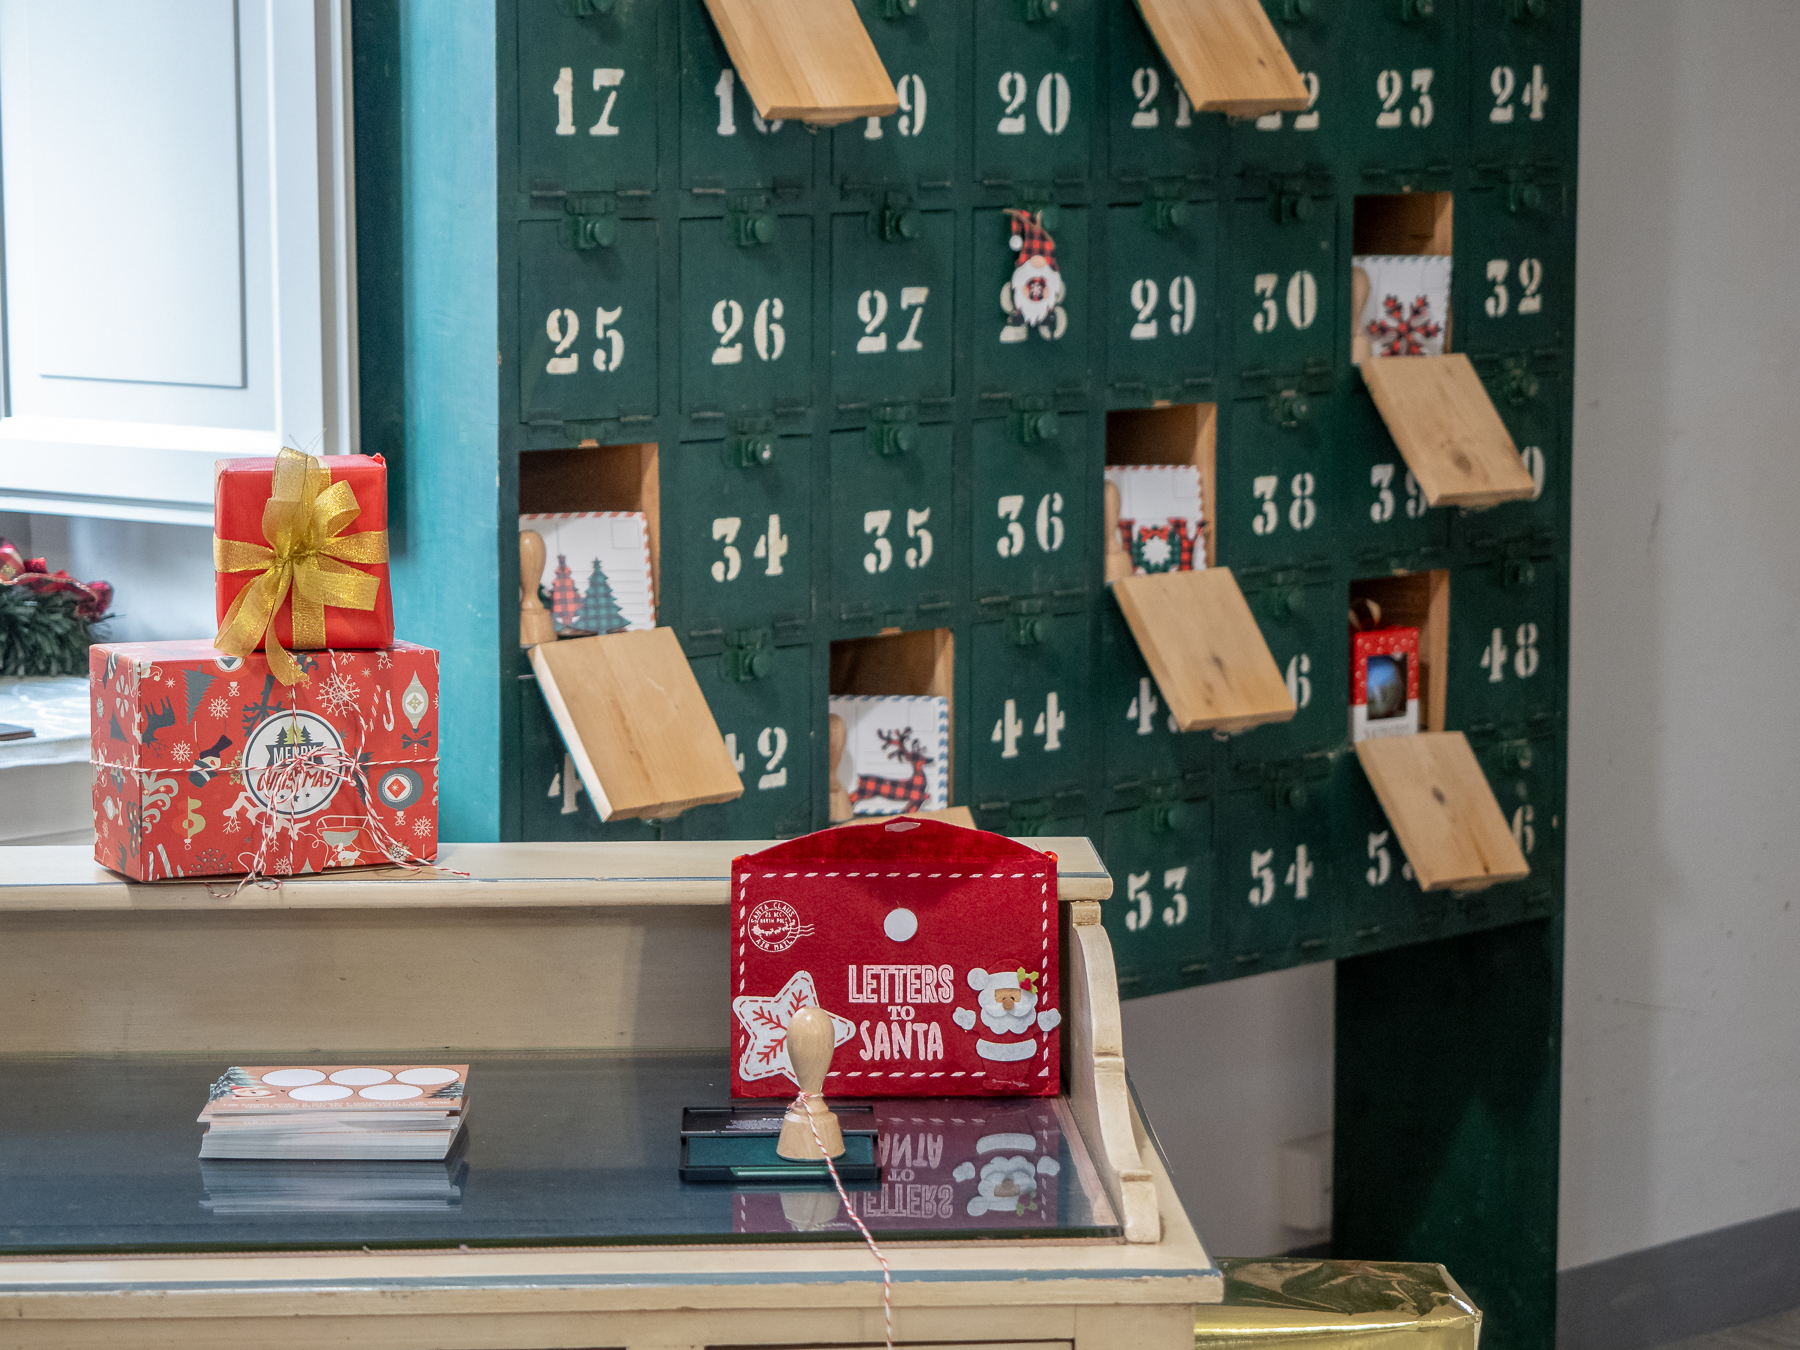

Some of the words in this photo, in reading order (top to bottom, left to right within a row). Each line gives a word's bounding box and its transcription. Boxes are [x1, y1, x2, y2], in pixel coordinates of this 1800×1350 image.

[553, 67, 625, 136] 17
[715, 70, 783, 136] 1
[998, 72, 1070, 134] 20
[1377, 69, 1433, 127] 23
[1490, 65, 1547, 122] 24
[1131, 276, 1196, 340] 29
[1254, 271, 1317, 332] 30
[1486, 259, 1541, 316] 32
[546, 306, 625, 375] 25
[712, 298, 785, 365] 26
[857, 287, 929, 353] 27
[997, 493, 1064, 557] 36
[1253, 473, 1315, 535] 38
[711, 514, 788, 582] 34
[864, 507, 933, 574] 35
[1481, 624, 1538, 681] 48
[992, 692, 1065, 758] 44
[1127, 678, 1180, 734] 4
[257, 770, 333, 792] CHRISMAS
[1249, 845, 1312, 906] 54
[1367, 832, 1411, 884] 5
[773, 902, 795, 917] CLAUS
[1126, 867, 1187, 931] 53
[756, 938, 770, 950] AIR
[773, 939, 793, 951] MAIL
[848, 964, 955, 1004] LETTERS
[888, 1005, 915, 1020] TO
[859, 1020, 944, 1061] SANTA
